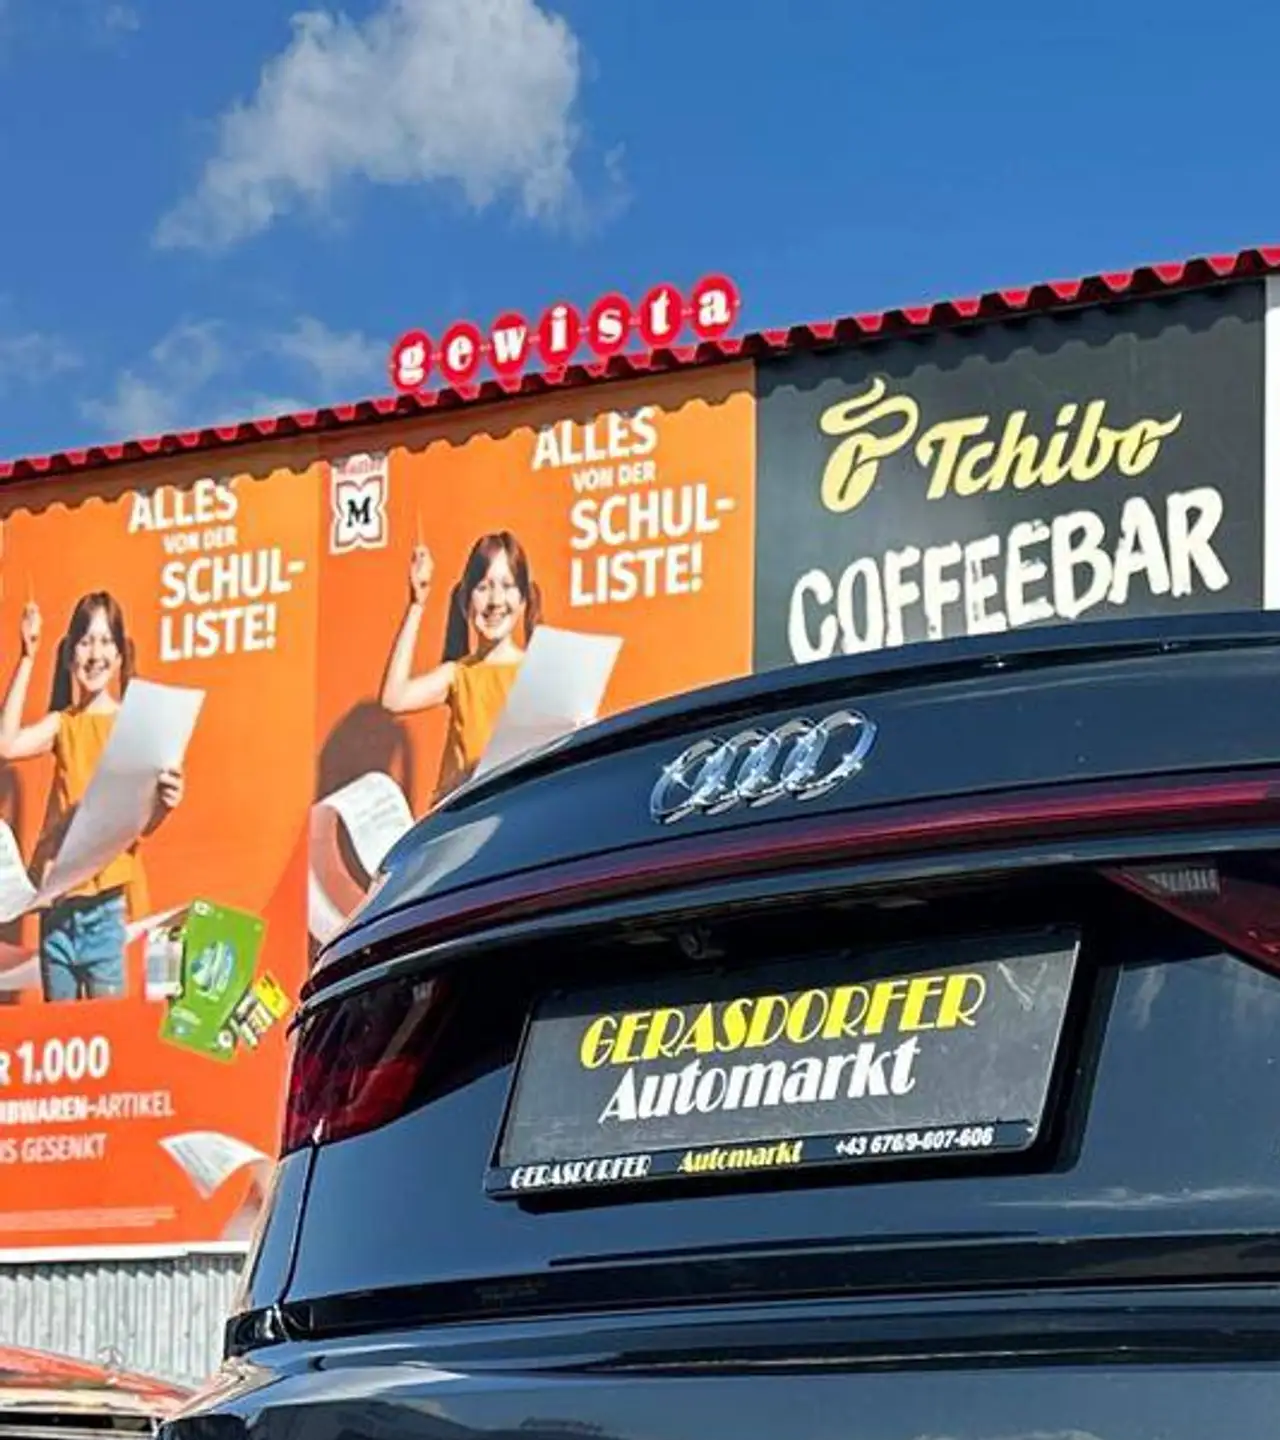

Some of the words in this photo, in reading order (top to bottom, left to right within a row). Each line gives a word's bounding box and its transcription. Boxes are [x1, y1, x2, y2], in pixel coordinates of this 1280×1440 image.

[399, 289, 731, 386] gewista
[531, 406, 657, 471] ALLES
[916, 400, 1182, 500] Tchibo
[128, 478, 238, 534] ALLES
[572, 467, 614, 493] VON
[618, 460, 656, 487] DER
[163, 530, 200, 555] VON
[203, 524, 237, 551] DER
[346, 496, 372, 528] M
[570, 483, 735, 550] SCHUL-
[160, 546, 305, 609] SCHUL-
[570, 540, 703, 607] LISTE!
[788, 487, 1229, 664] COFFEEBAR
[160, 602, 277, 662] LISTE!
[580, 973, 986, 1069] GERASDORFER
[16, 1036, 111, 1085] 1.000
[597, 1037, 921, 1124] Automarkt
[510, 1155, 651, 1189] GERASDORFER
[677, 1140, 803, 1173] Automarkt
